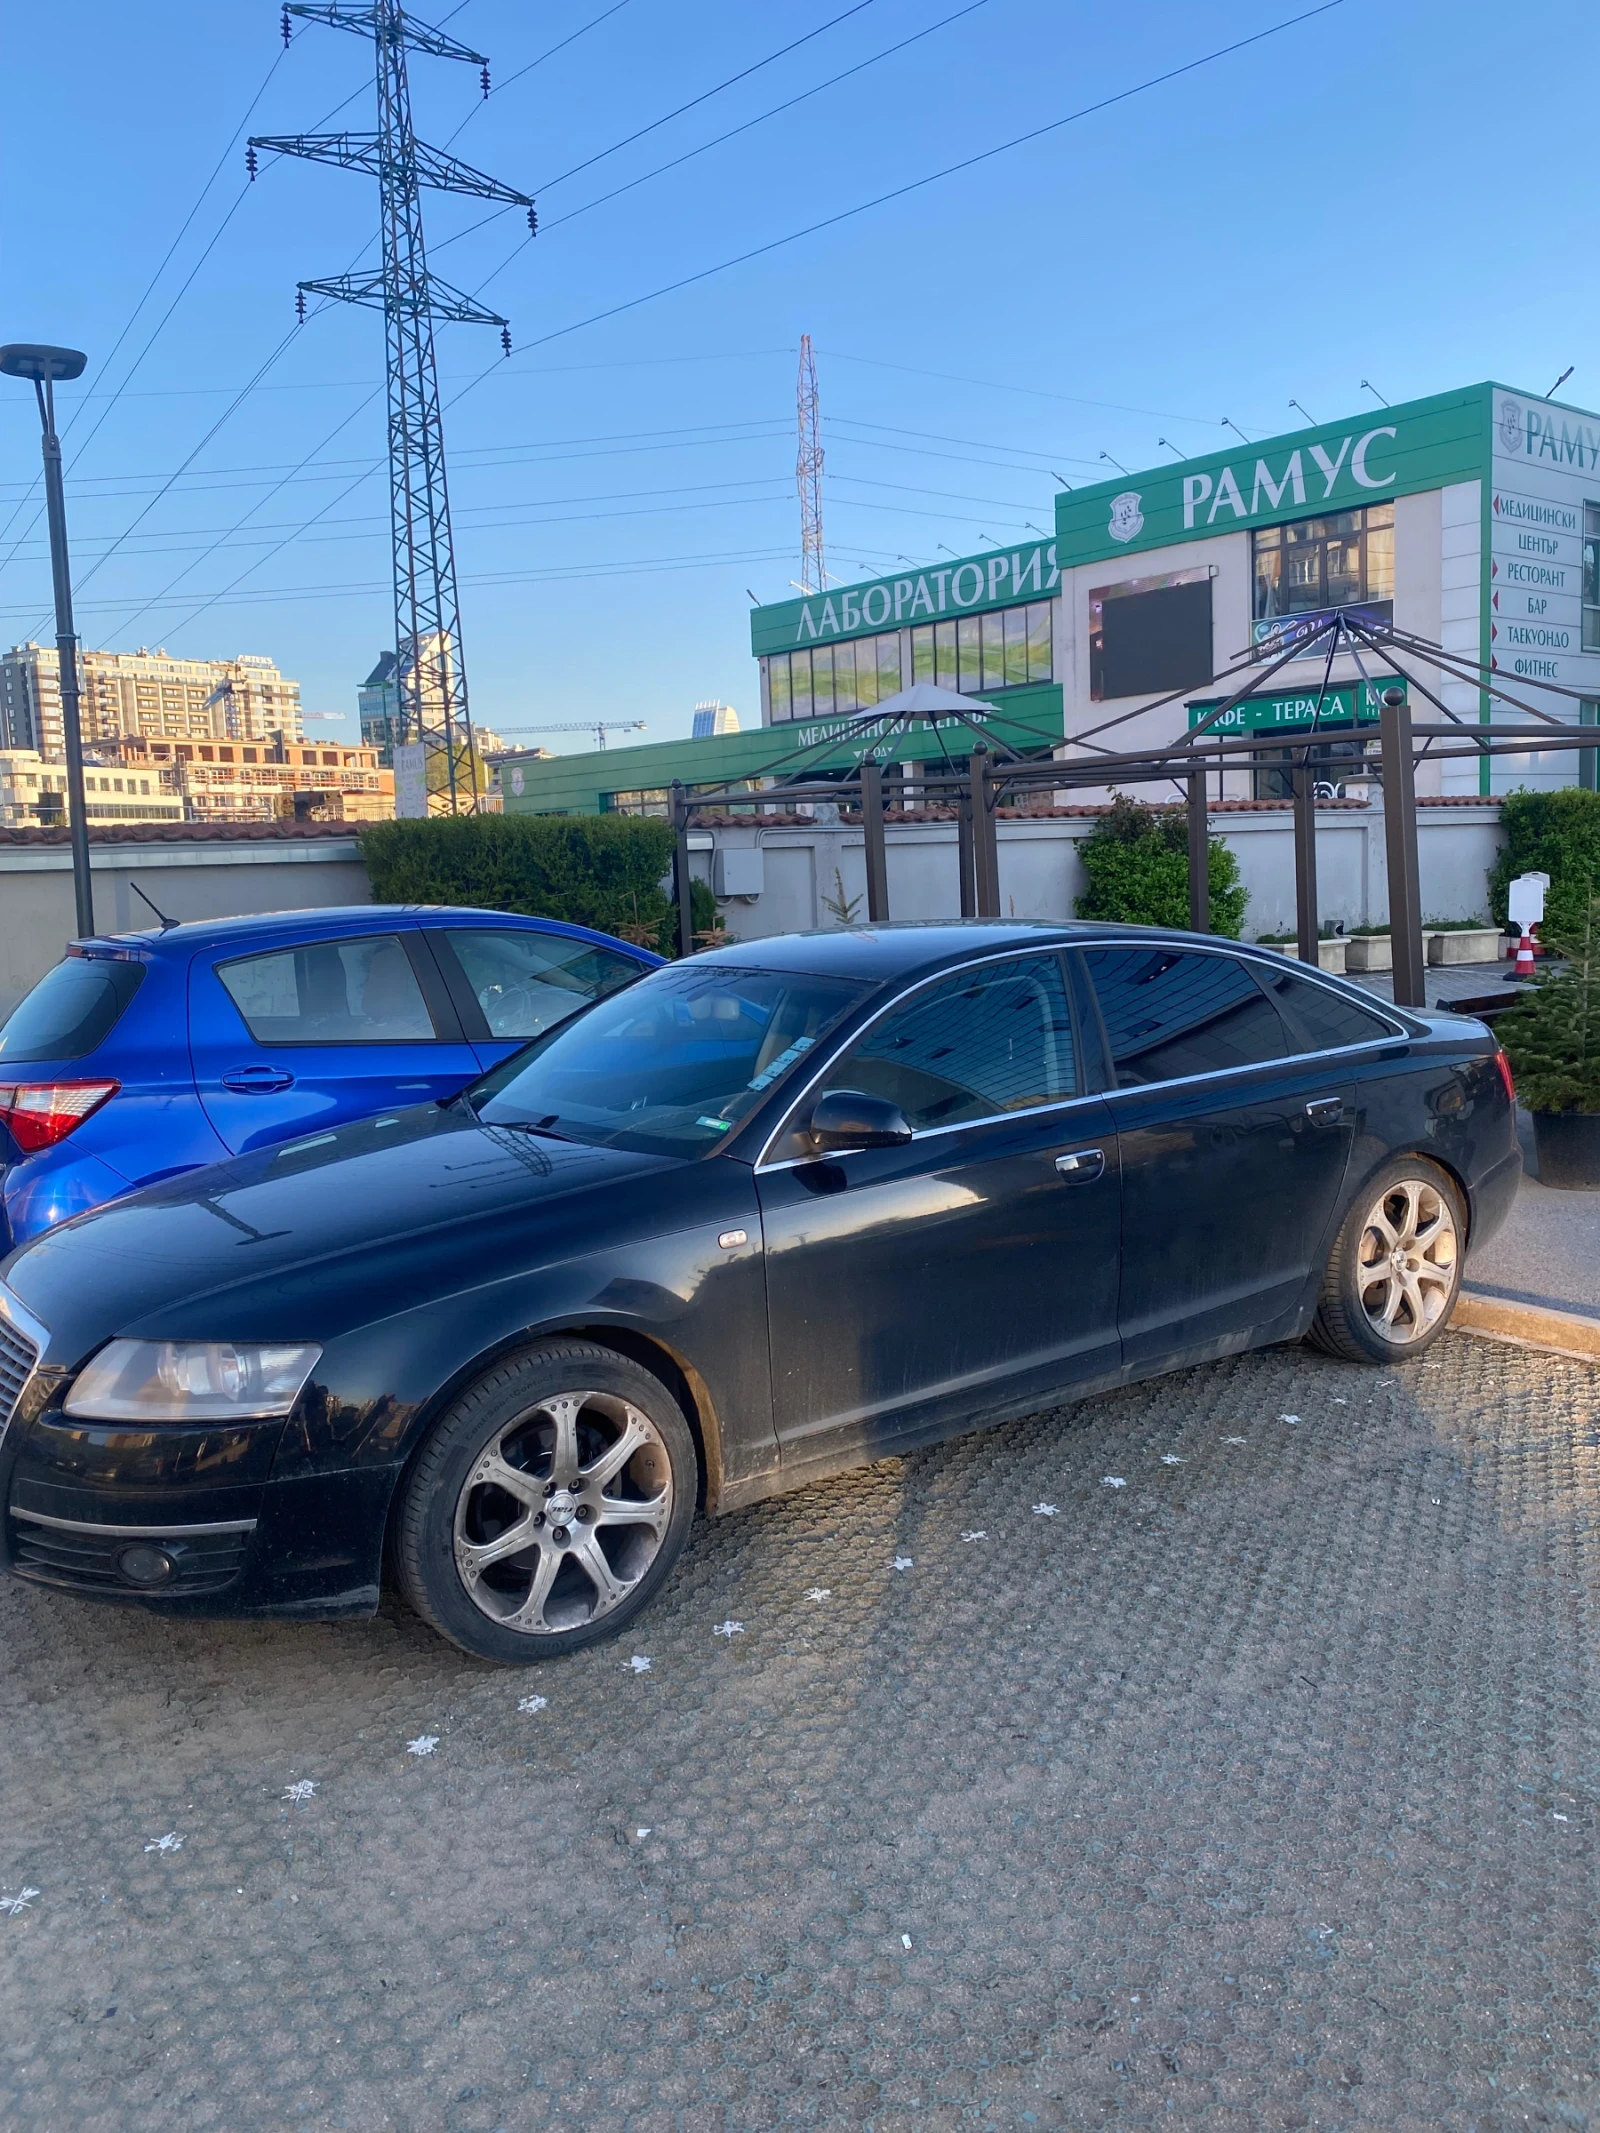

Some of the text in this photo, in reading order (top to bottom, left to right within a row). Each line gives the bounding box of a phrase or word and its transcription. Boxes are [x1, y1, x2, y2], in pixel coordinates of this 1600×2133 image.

[1182, 426, 1398, 530] РАМУС
[1500, 498, 1576, 529] МЕДИЦИНСКИ
[1518, 533, 1559, 555] ЦЕНТЪР
[1507, 563, 1566, 587] РЕСТОРАНТ
[1527, 598, 1547, 615] БАР
[1507, 626, 1570, 648] ТАЕКУОНДО
[1514, 658, 1559, 678] ФИТНЕС
[1272, 696, 1345, 721] ТЕРАСА
